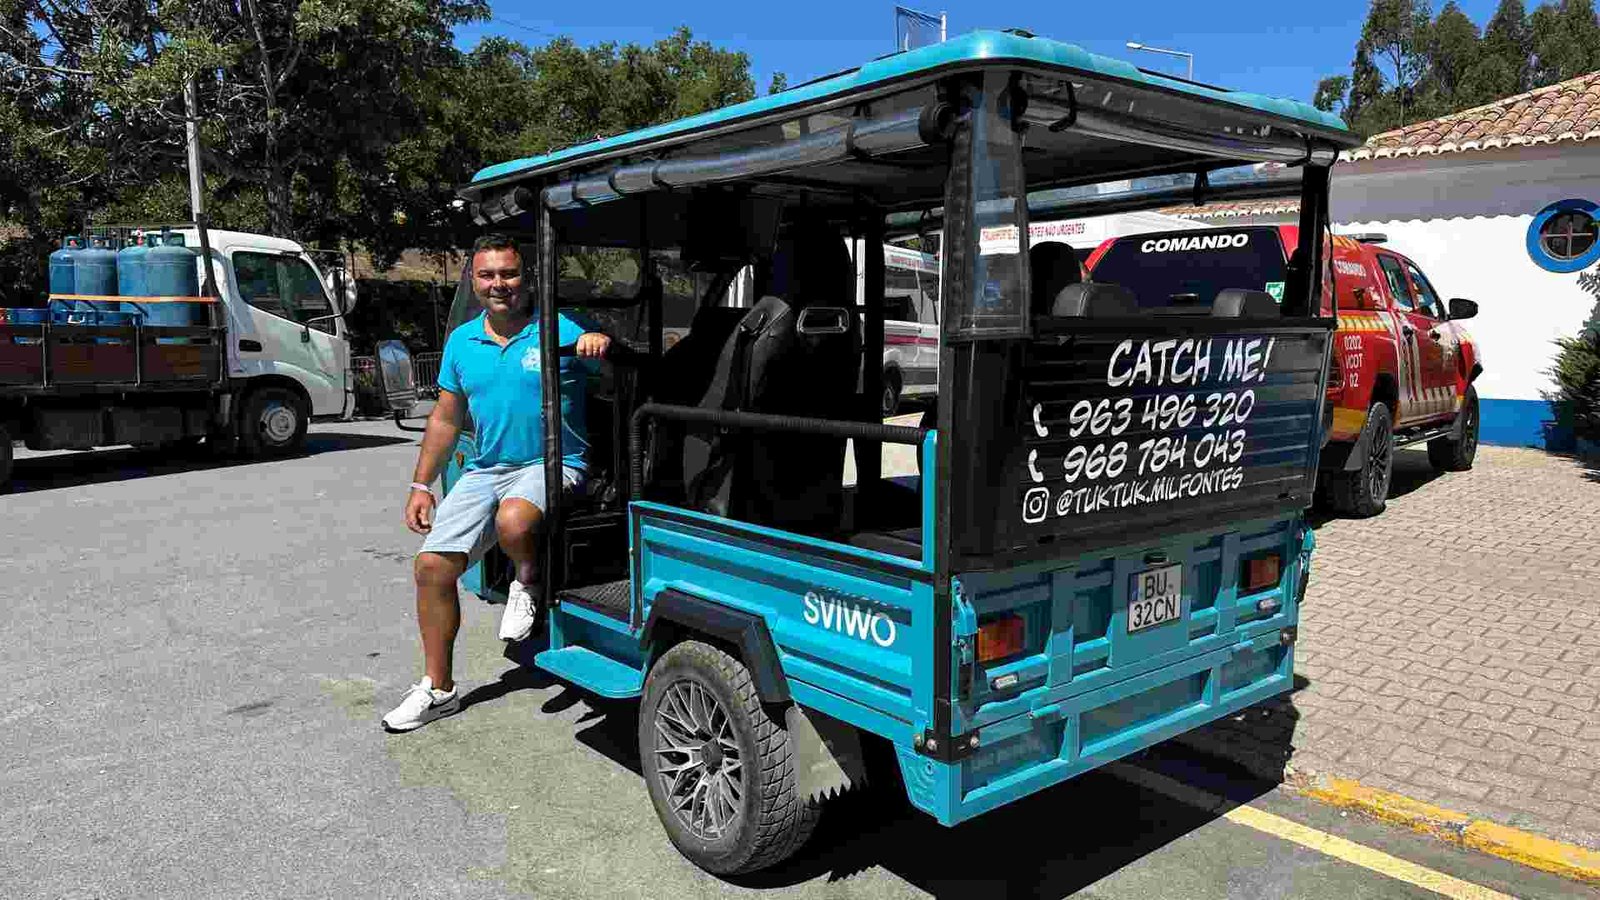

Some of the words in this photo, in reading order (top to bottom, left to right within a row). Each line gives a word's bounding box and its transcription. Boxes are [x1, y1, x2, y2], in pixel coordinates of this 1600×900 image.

[1141, 233, 1248, 253] COMANDO
[1333, 259, 1367, 277] COMANDO
[1107, 338, 1213, 387] CATCH
[1218, 336, 1276, 382] ME!
[1344, 335, 1363, 350] 0202
[1349, 372, 1359, 388] 02
[1069, 397, 1133, 438] 963
[1141, 393, 1197, 431] 496
[1202, 389, 1255, 428] 320
[1063, 441, 1128, 483] 968
[1138, 434, 1188, 476] 784
[1193, 429, 1246, 468] 043
[1056, 466, 1243, 516] @TUKTUK.MILFONTES
[803, 591, 896, 647] SVIWO
[1133, 594, 1176, 628] 32CN
